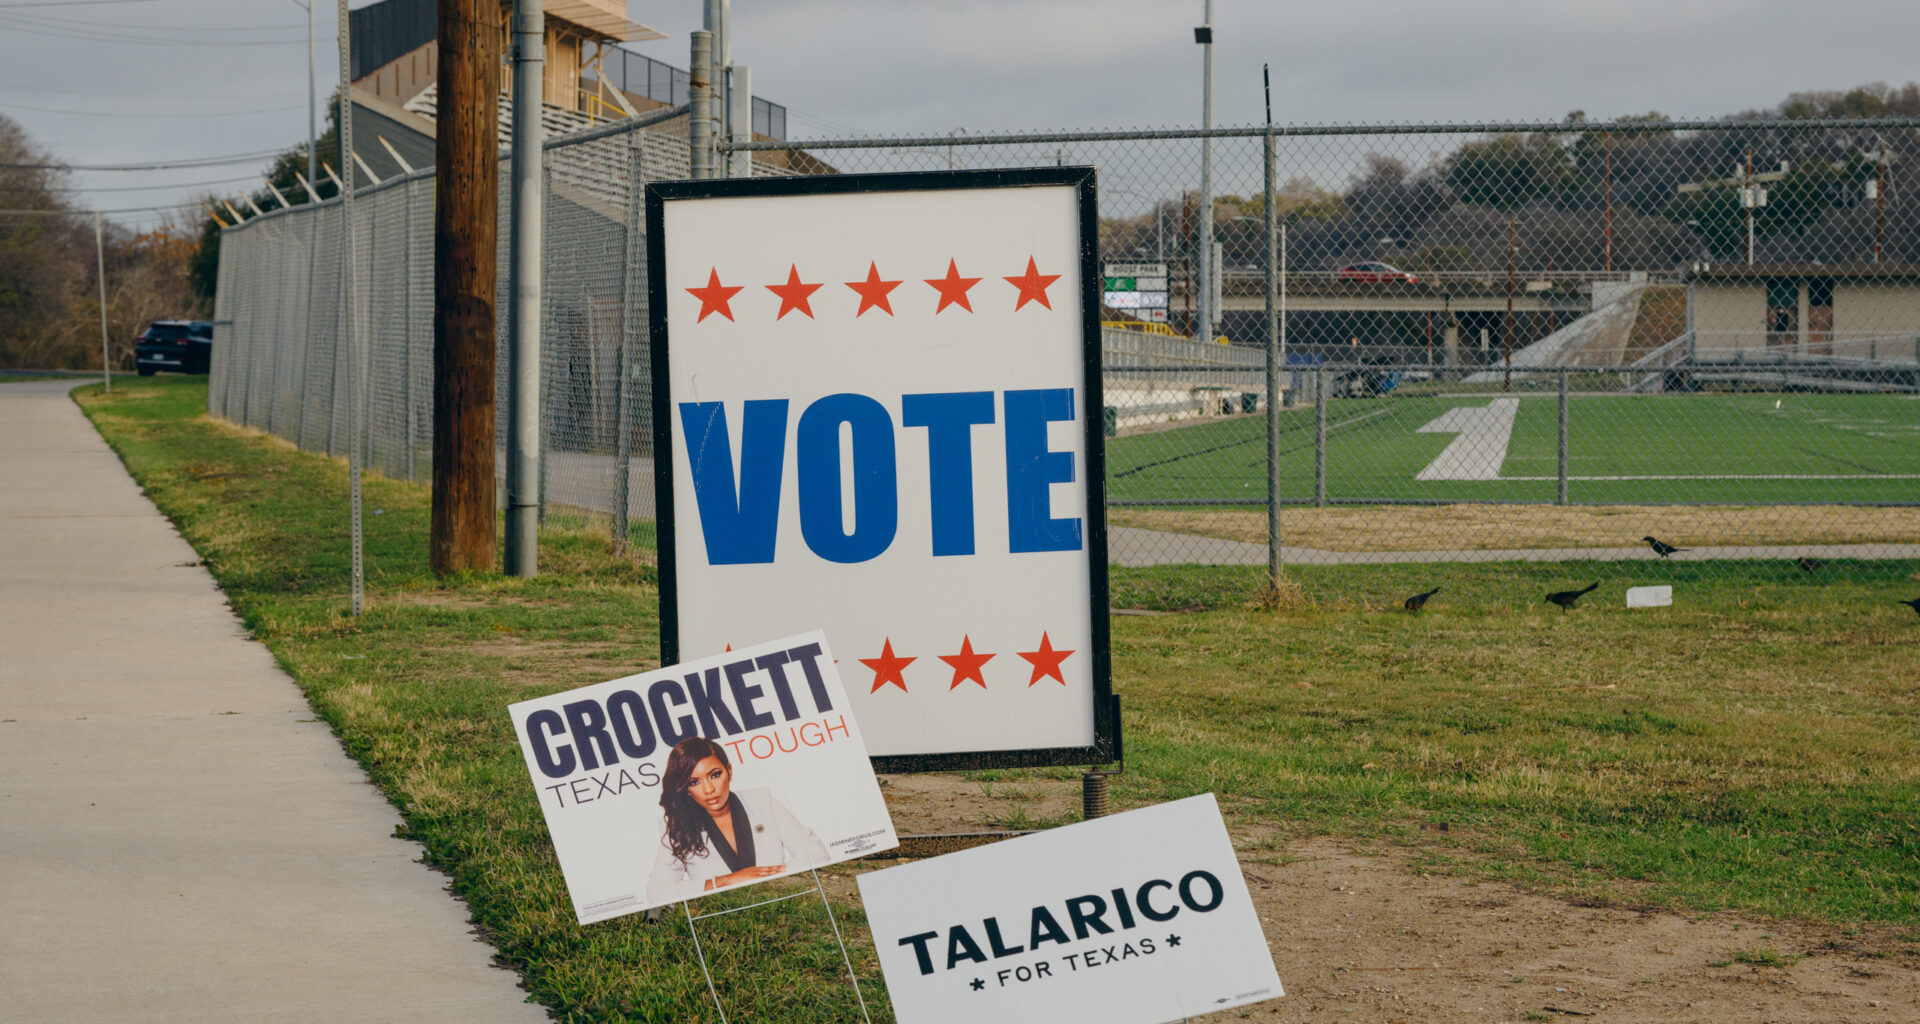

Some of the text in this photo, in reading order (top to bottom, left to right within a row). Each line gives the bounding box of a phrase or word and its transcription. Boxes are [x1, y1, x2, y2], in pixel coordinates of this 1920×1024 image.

[679, 388, 1082, 566] VOTE
[525, 642, 834, 778] CROCKETT
[724, 714, 850, 765] TOUGH
[545, 762, 660, 808] TEXAS
[829, 828, 886, 848] JASMINEFORUS.COM
[898, 869, 1224, 975] TALARICO
[997, 938, 1156, 986] FOR TEXAS
